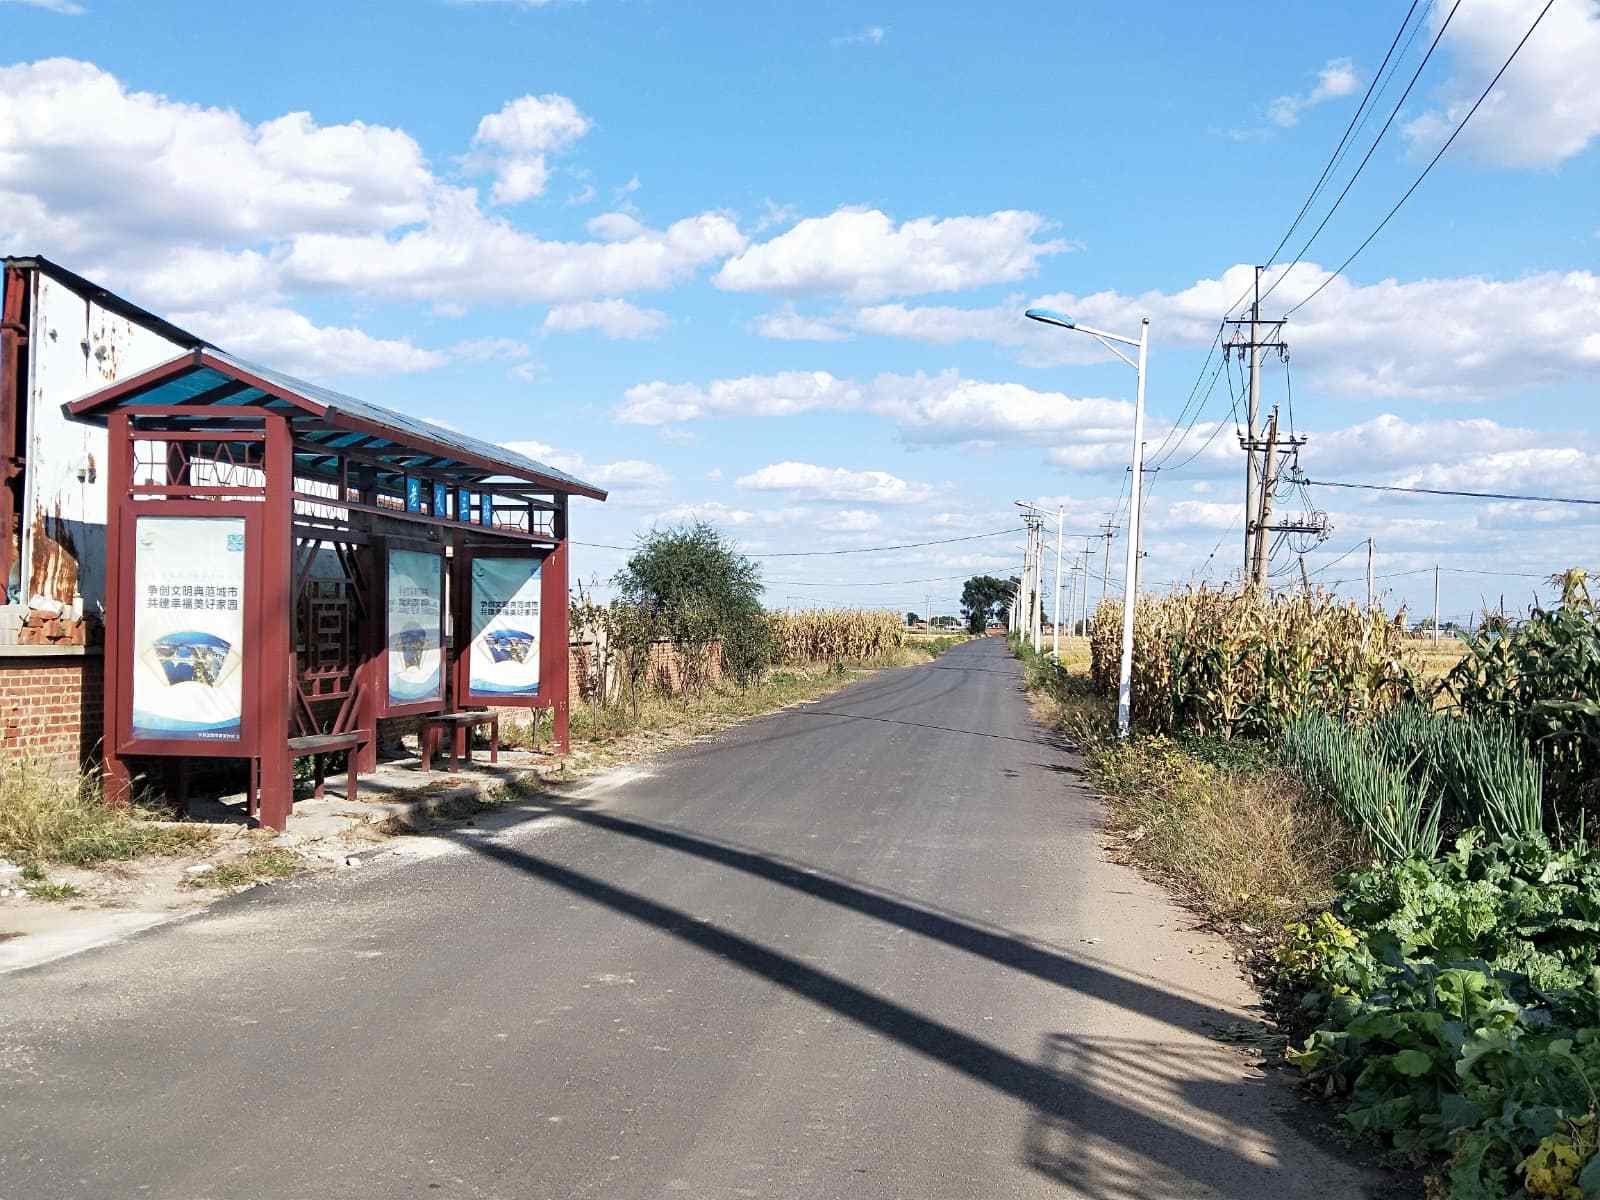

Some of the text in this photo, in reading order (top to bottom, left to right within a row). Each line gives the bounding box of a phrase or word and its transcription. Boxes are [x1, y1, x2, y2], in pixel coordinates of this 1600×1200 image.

[147, 585, 239, 597] 争创文明典范城市
[146, 598, 239, 610] 共建幸福美好家园
